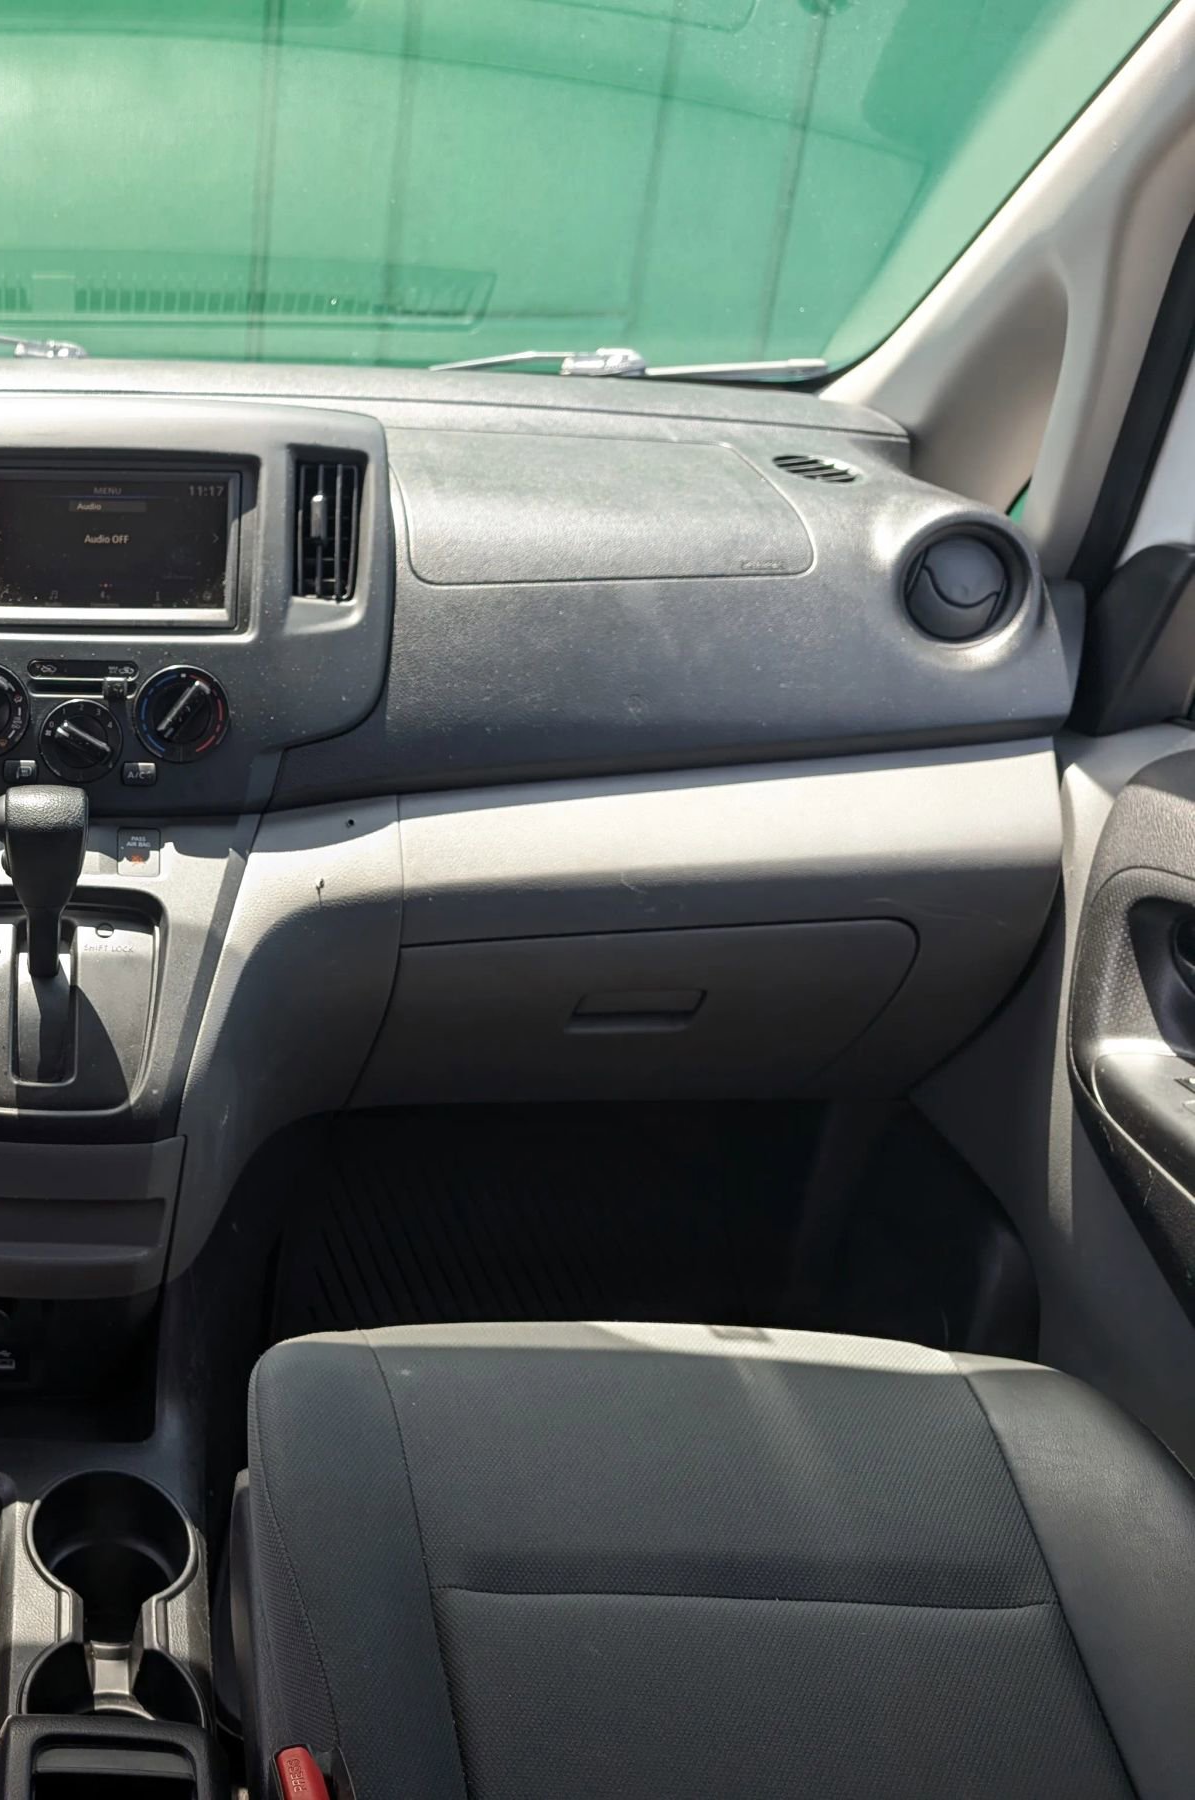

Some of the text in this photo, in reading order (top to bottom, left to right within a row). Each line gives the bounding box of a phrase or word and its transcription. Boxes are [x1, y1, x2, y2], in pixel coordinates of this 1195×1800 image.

[93, 487, 122, 495] MENU
[188, 485, 225, 497] 11:17
[77, 503, 102, 511] Audio
[84, 534, 130, 545] Audio OFF
[127, 770, 145, 780] A/C
[84, 943, 134, 953] SHIFT LOCK
[286, 1758, 307, 1792] PRESS
